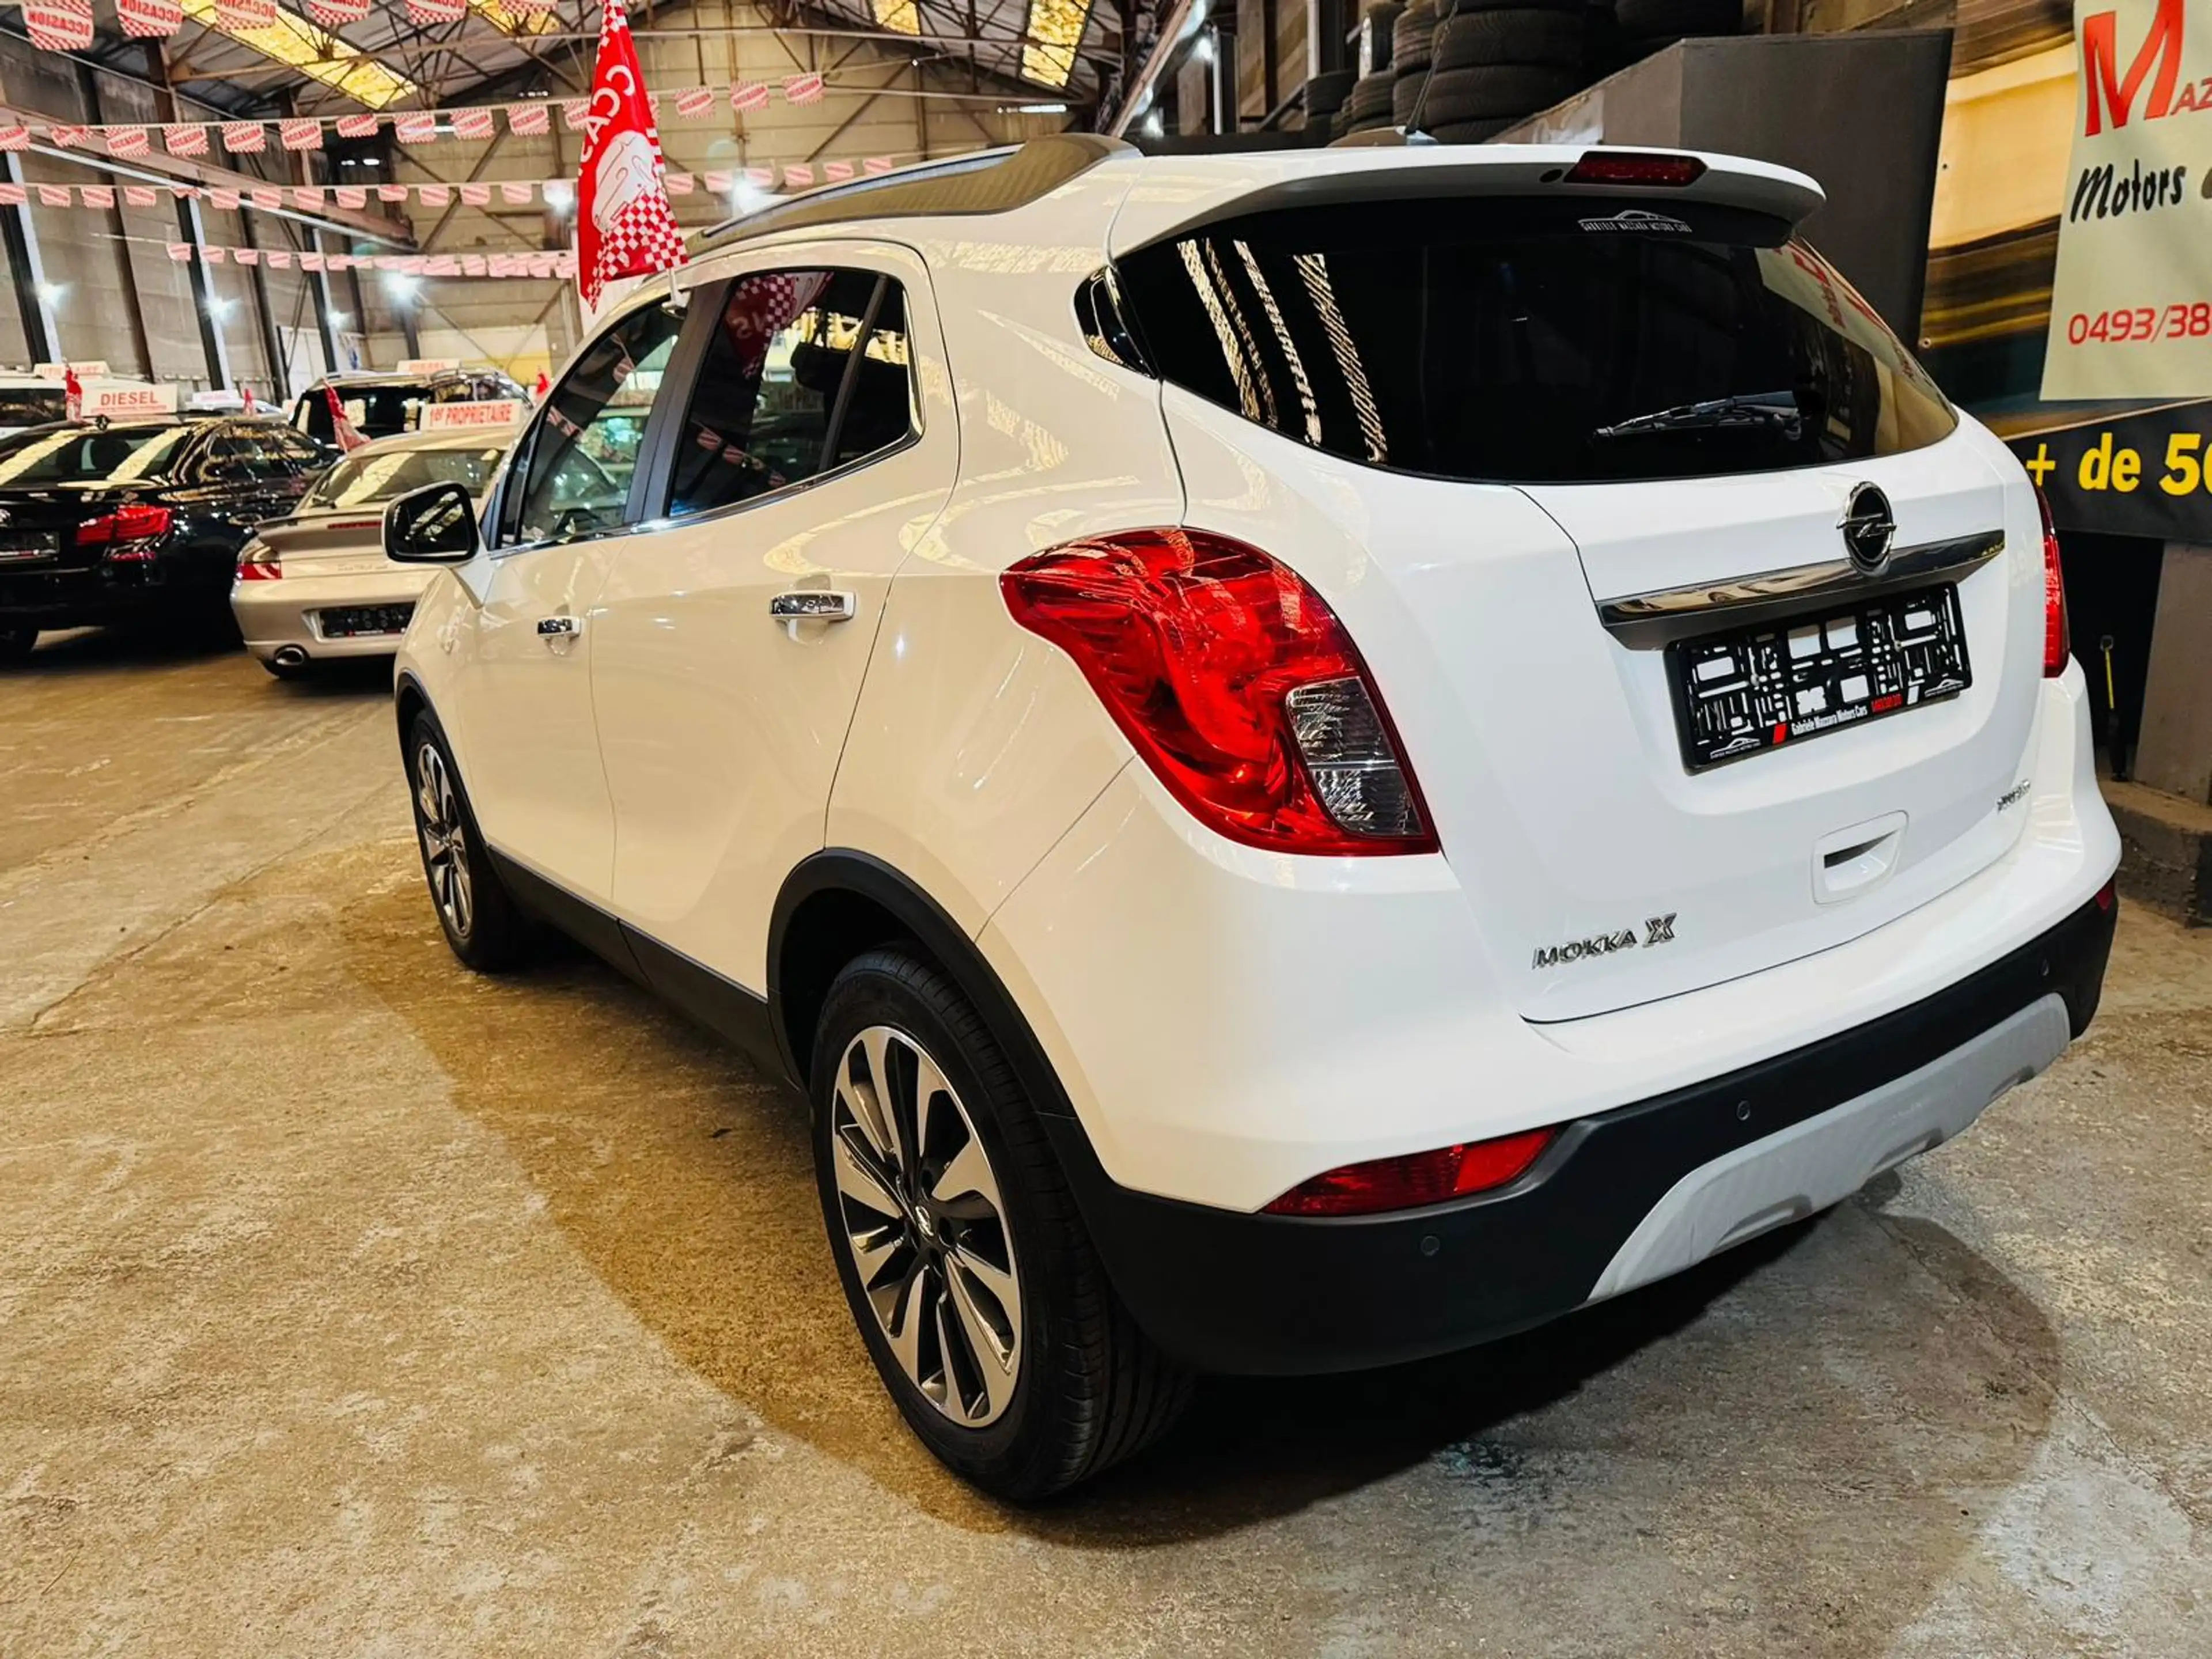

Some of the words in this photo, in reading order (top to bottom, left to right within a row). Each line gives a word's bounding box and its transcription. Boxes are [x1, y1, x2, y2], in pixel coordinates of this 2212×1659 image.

[2070, 158, 2187, 224] Motors
[2068, 302, 2212, 345] 0493/38
[100, 390, 158, 406] DIESEL
[2078, 432, 2141, 493] de
[2158, 433, 2212, 496] 5
[1532, 911, 1638, 969] MOKKA
[1642, 912, 1677, 949] X
